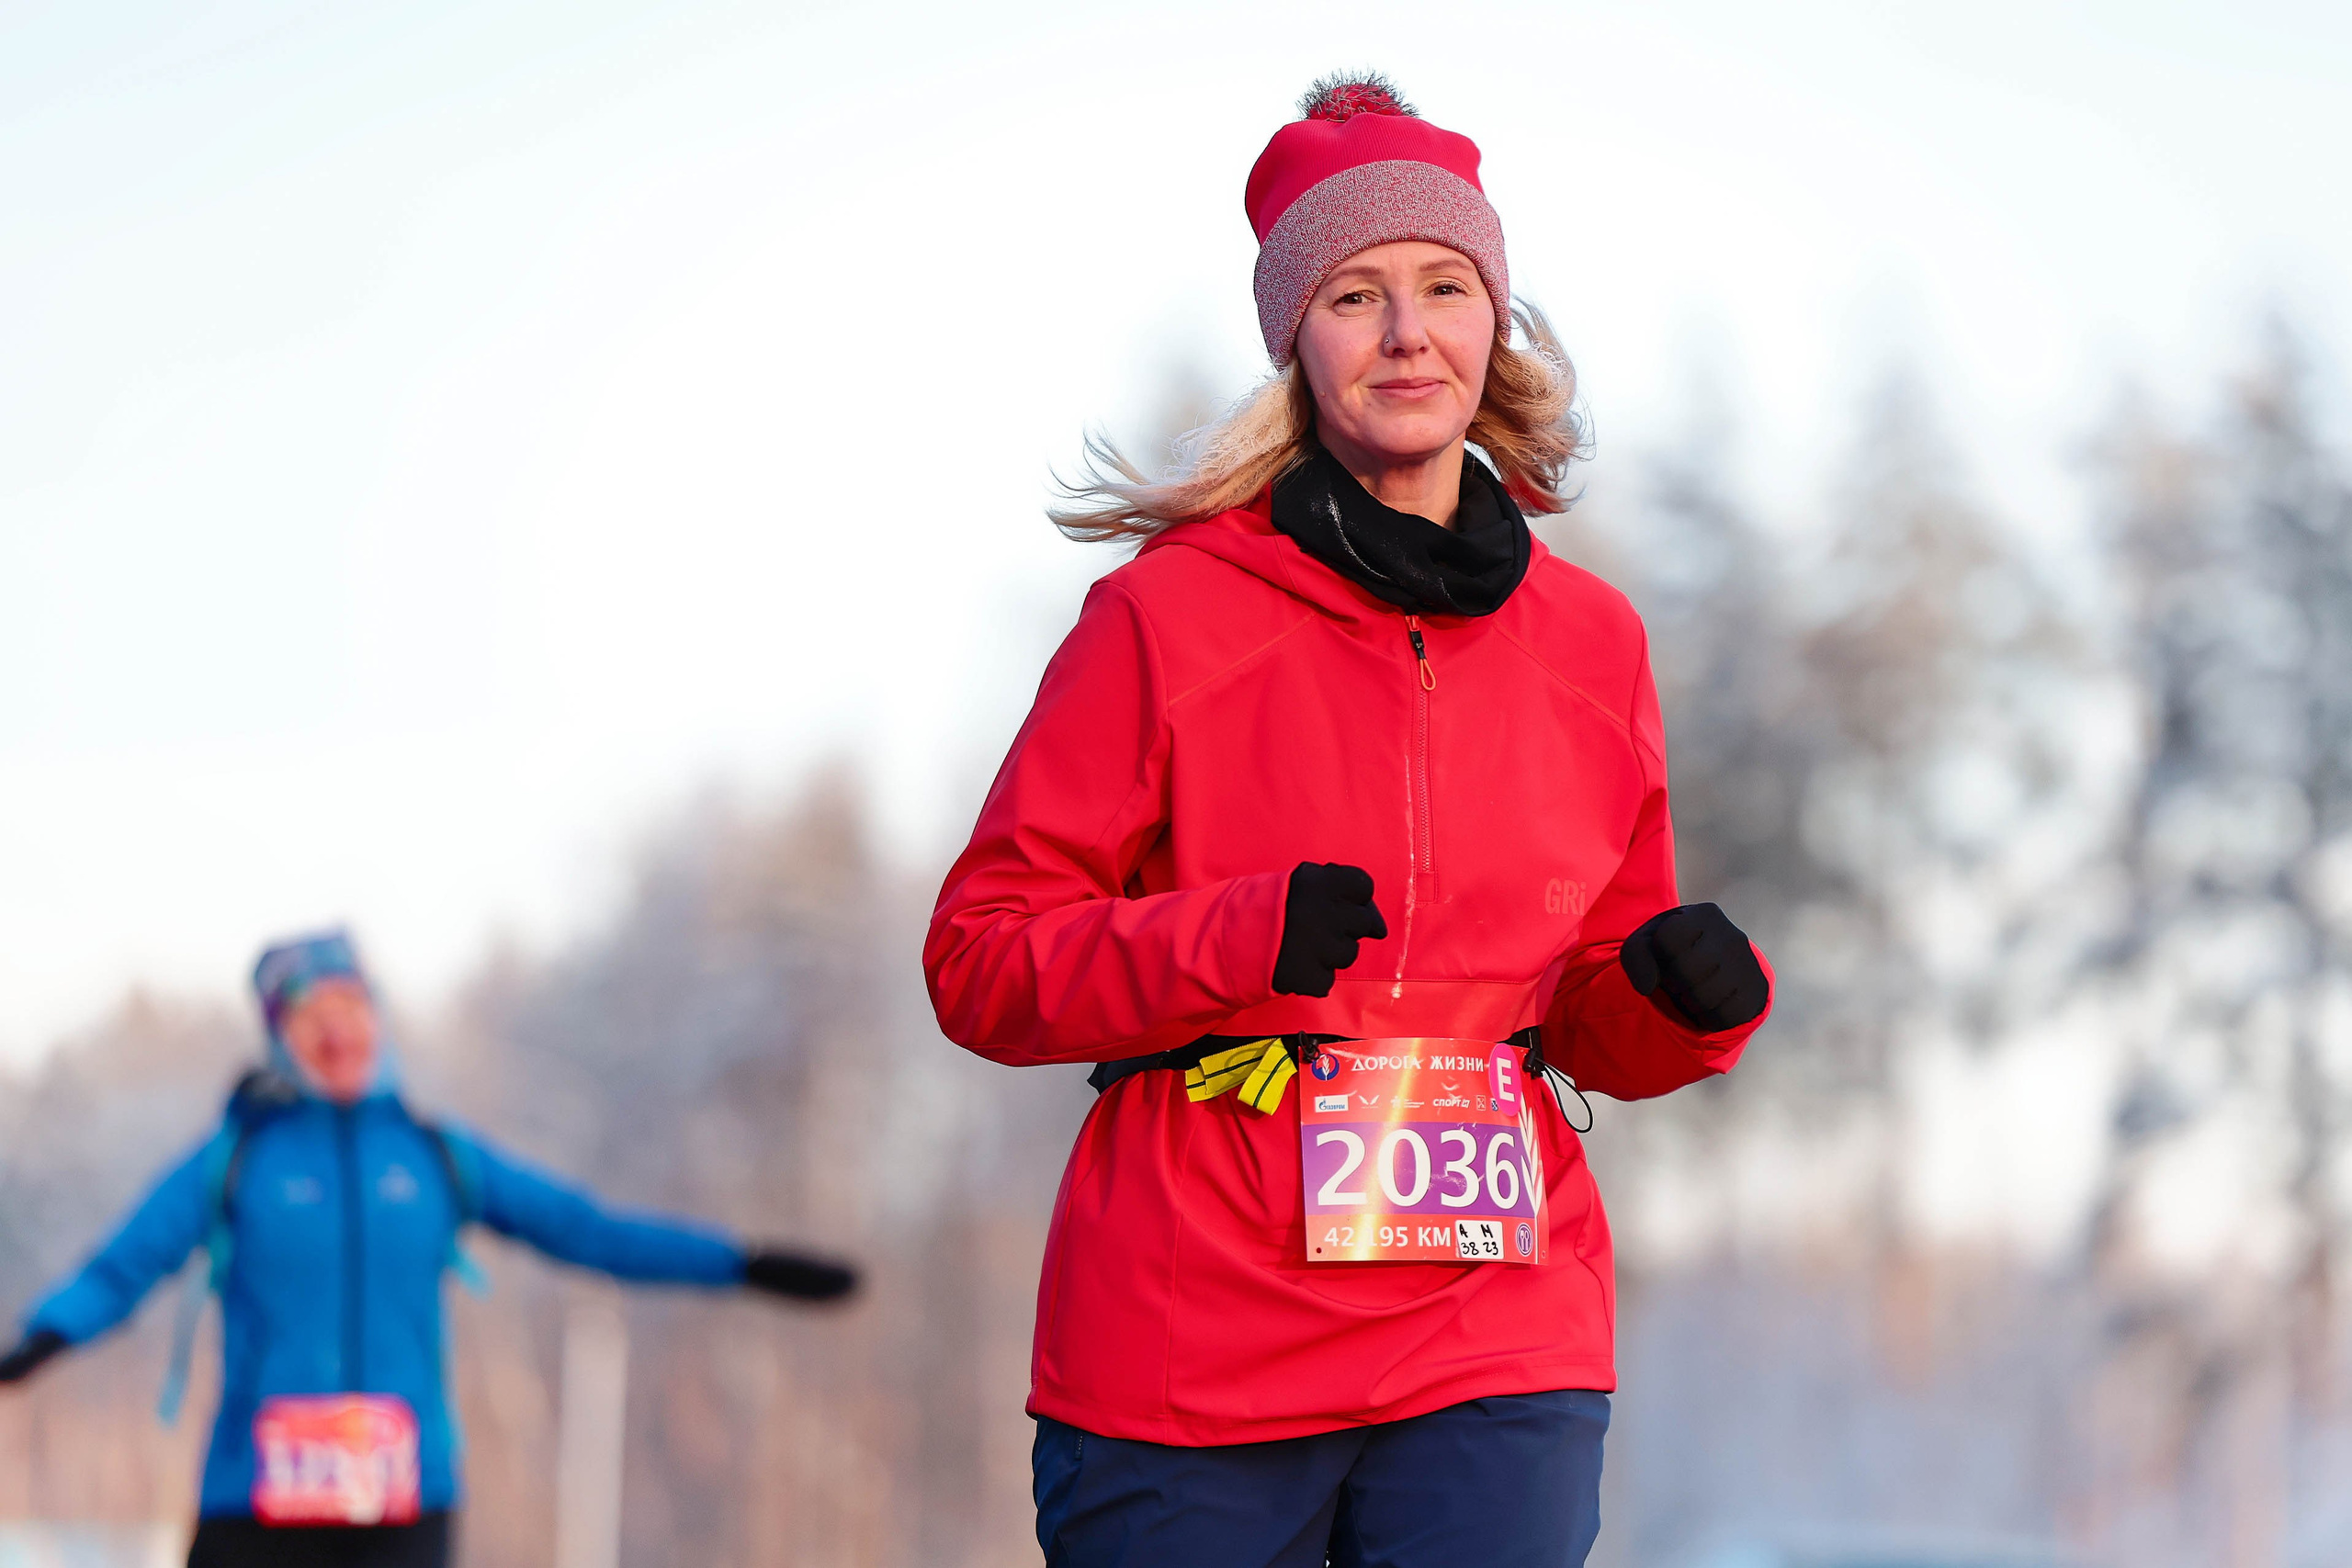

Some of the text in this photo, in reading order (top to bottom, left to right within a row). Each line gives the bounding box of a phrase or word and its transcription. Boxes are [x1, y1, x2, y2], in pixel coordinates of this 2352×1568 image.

[1351, 1055, 1484, 1072] ДОРОГА ЖИЗНИ
[1316, 1129, 1520, 1210] 2036
[1461, 1242, 1498, 1255] 38 23
